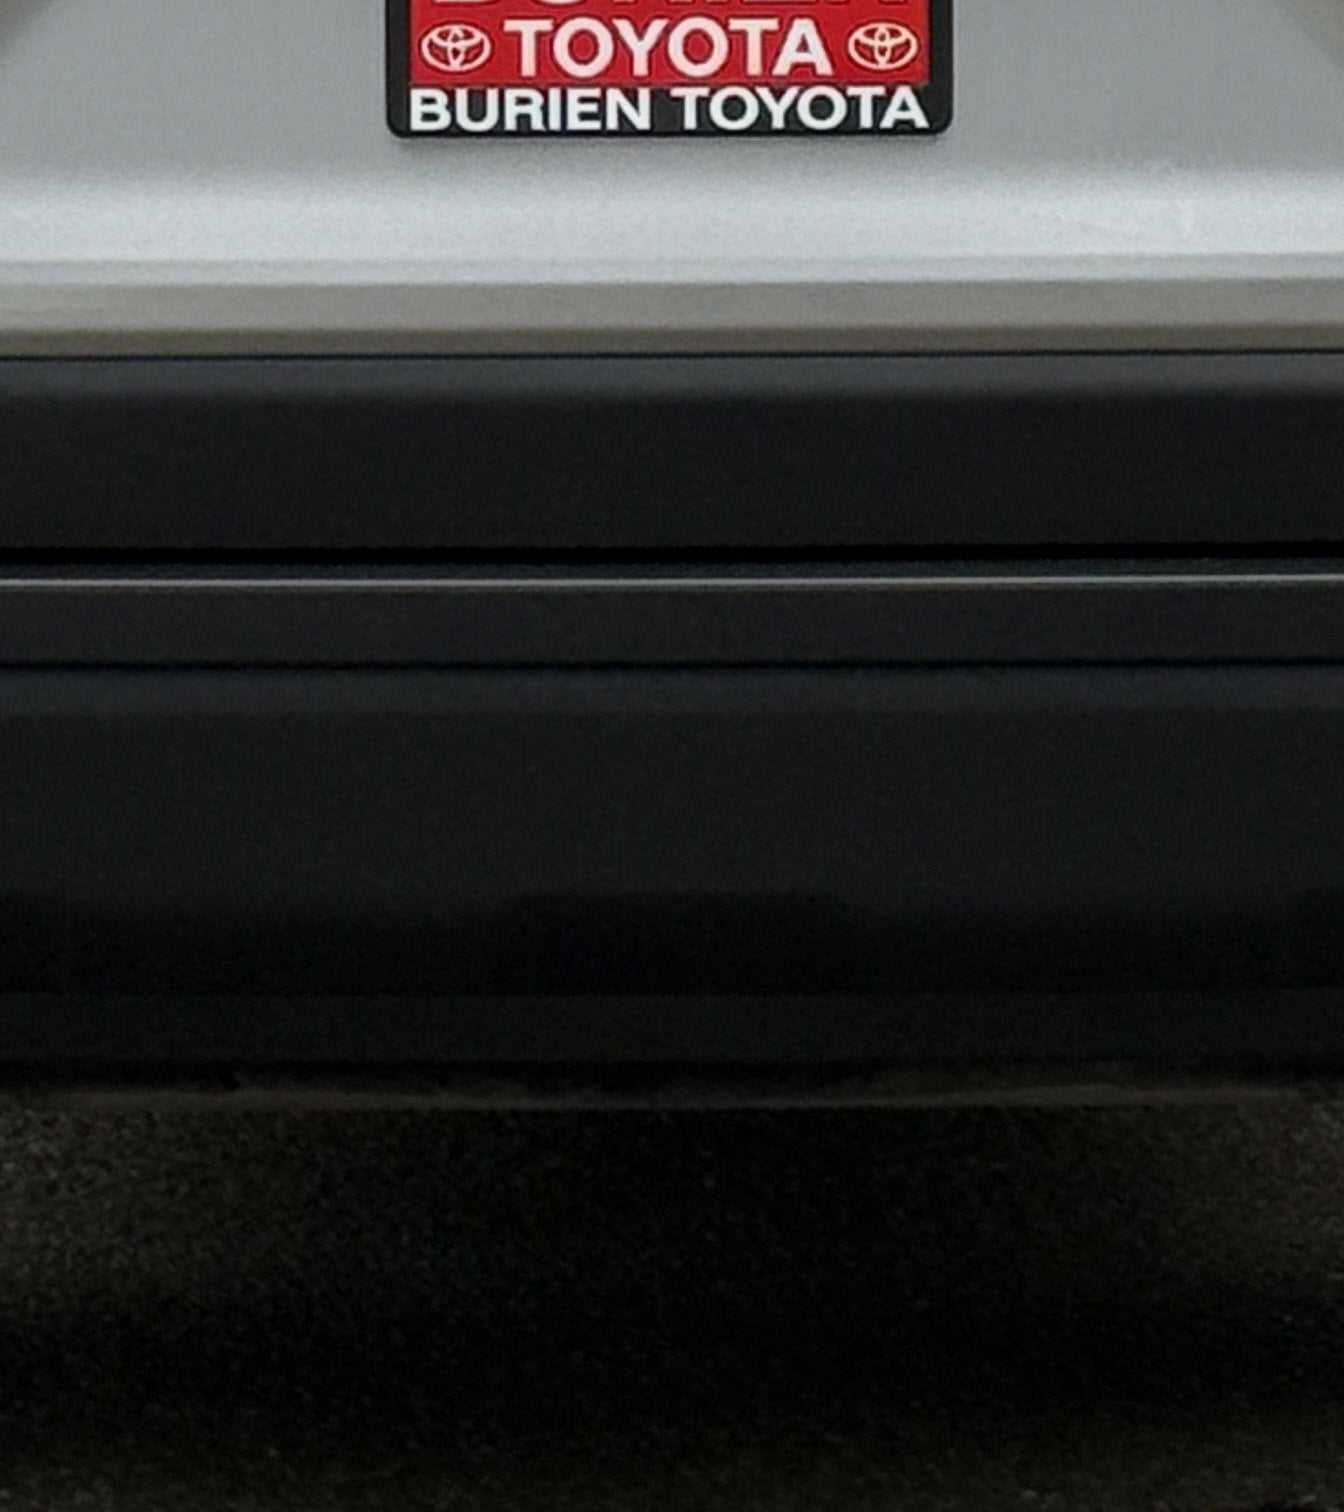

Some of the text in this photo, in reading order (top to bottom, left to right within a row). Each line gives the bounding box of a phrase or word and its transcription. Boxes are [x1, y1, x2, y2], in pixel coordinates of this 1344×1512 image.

[503, 17, 835, 78] TOYOTA
[409, 86, 930, 131] BURIEN TOYOTA
